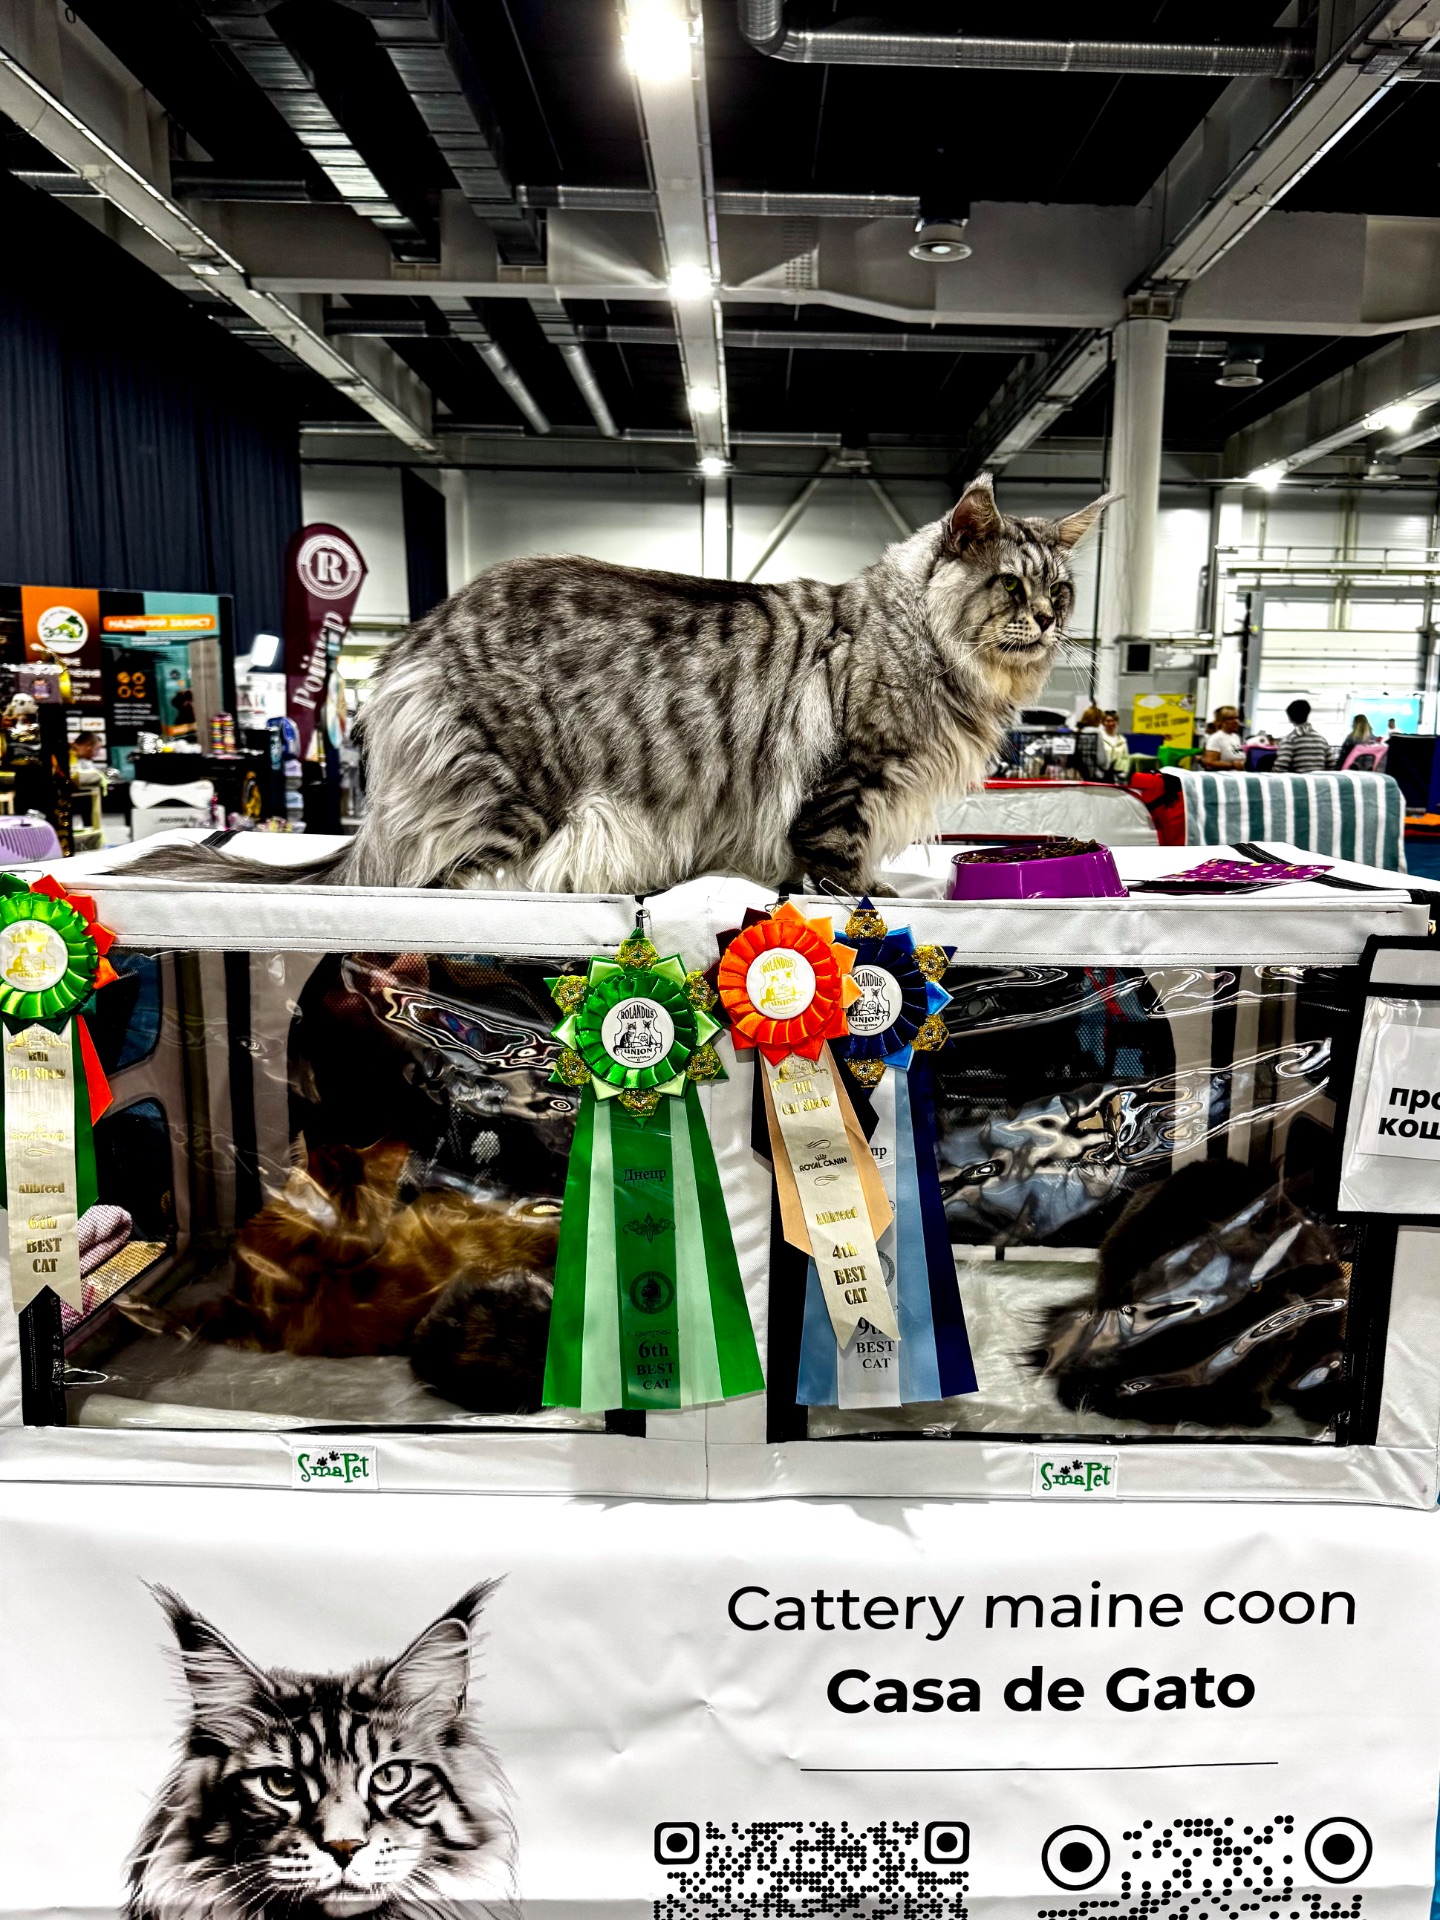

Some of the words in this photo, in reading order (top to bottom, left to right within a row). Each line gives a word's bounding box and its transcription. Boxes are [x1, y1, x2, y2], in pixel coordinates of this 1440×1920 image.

[316, 551, 344, 584] R
[762, 956, 794, 974] ROLANDUS
[854, 972, 883, 987] LANDUS
[771, 997, 799, 1007] UNION
[620, 1005, 655, 1020] ROLANDUS
[851, 1016, 880, 1024] UNION
[624, 1048, 653, 1056] UNION
[12, 1066, 31, 1080] Cat
[35, 1066, 66, 1080] Show
[782, 1101, 799, 1115] Cat
[802, 1096, 831, 1112] Show
[799, 1162, 821, 1172] ROYAL
[824, 1157, 848, 1168] CANIN
[624, 1168, 667, 1183] Днепр
[28, 1214, 57, 1230] 6th
[816, 1206, 858, 1225] Allbreed
[26, 1237, 62, 1254] BEST
[832, 1242, 859, 1259] 4th
[32, 1258, 58, 1273] CAT
[834, 1265, 867, 1286] BEST
[844, 1287, 868, 1306] CAT
[858, 1316, 884, 1336] 9t
[638, 1340, 669, 1359] 6th
[856, 1340, 895, 1354] BEST
[636, 1362, 675, 1376] BEST
[862, 1358, 891, 1369] CAT
[642, 1379, 672, 1390] CAT
[297, 1453, 370, 1483] SmaPet
[1040, 1462, 1112, 1492] SmaPet
[727, 1585, 965, 1641] Cattery
[985, 1580, 1184, 1629] maine
[1203, 1586, 1357, 1625] coon
[827, 1668, 981, 1714] Casa
[1003, 1665, 1085, 1712] de
[1105, 1667, 1256, 1712] Gato
